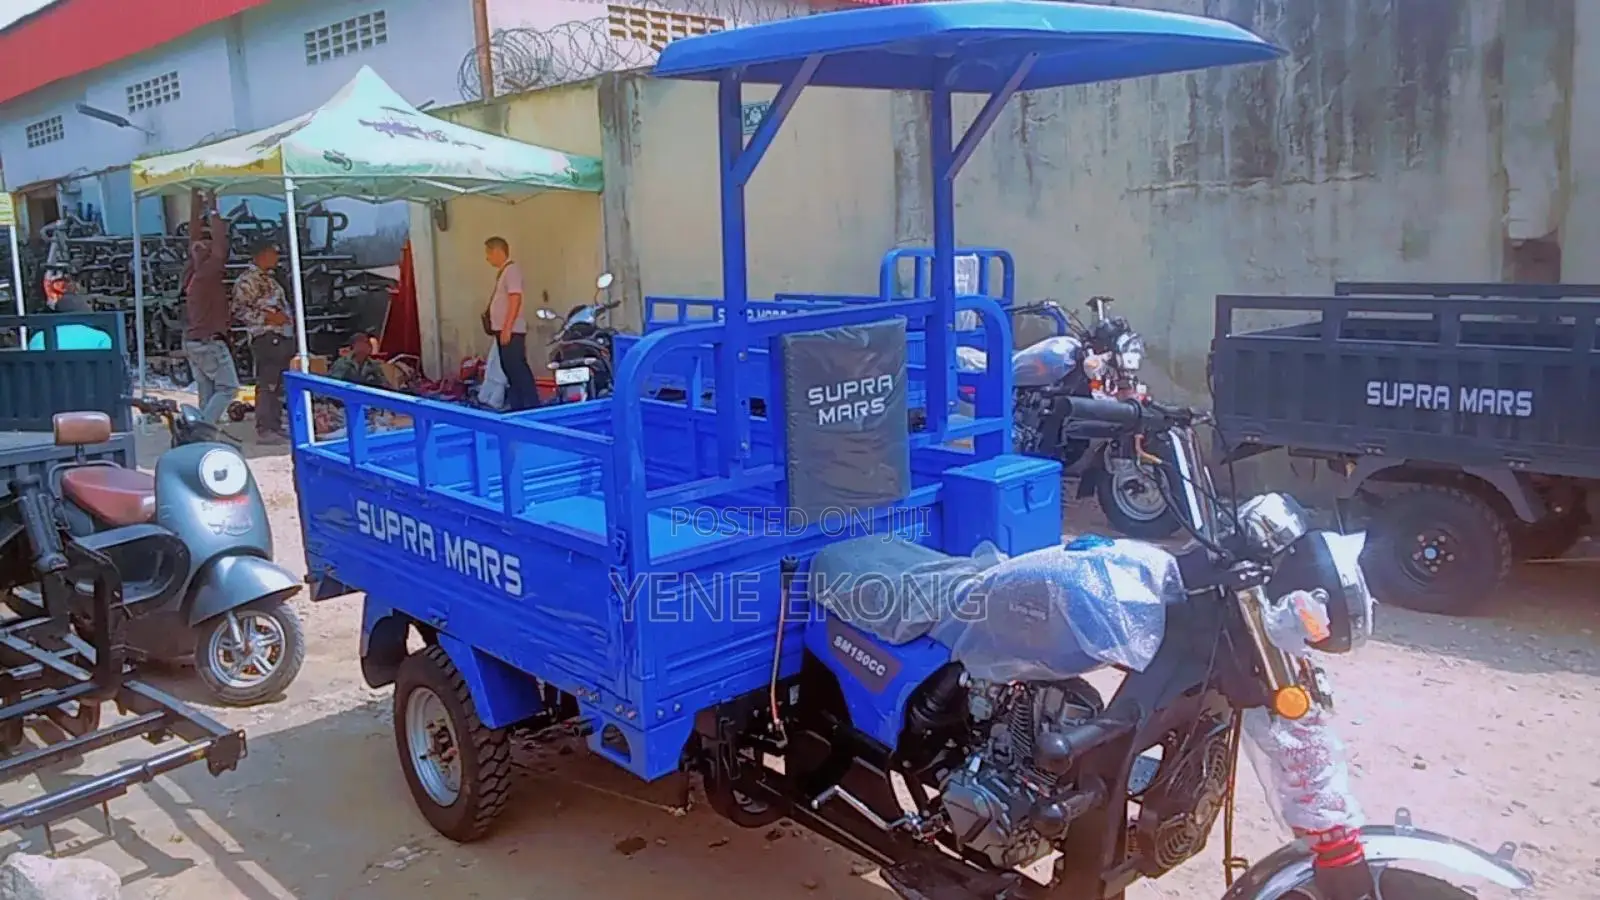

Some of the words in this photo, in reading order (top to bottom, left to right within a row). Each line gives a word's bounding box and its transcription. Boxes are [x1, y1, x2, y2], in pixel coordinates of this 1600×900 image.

[808, 374, 893, 405] SUPRA
[1366, 381, 1450, 411] SUPRA
[1459, 387, 1533, 417] MARS
[819, 397, 885, 425] MARS
[356, 500, 437, 562] SUPRA
[443, 531, 522, 596] MARS
[833, 635, 886, 676] SM150CC
